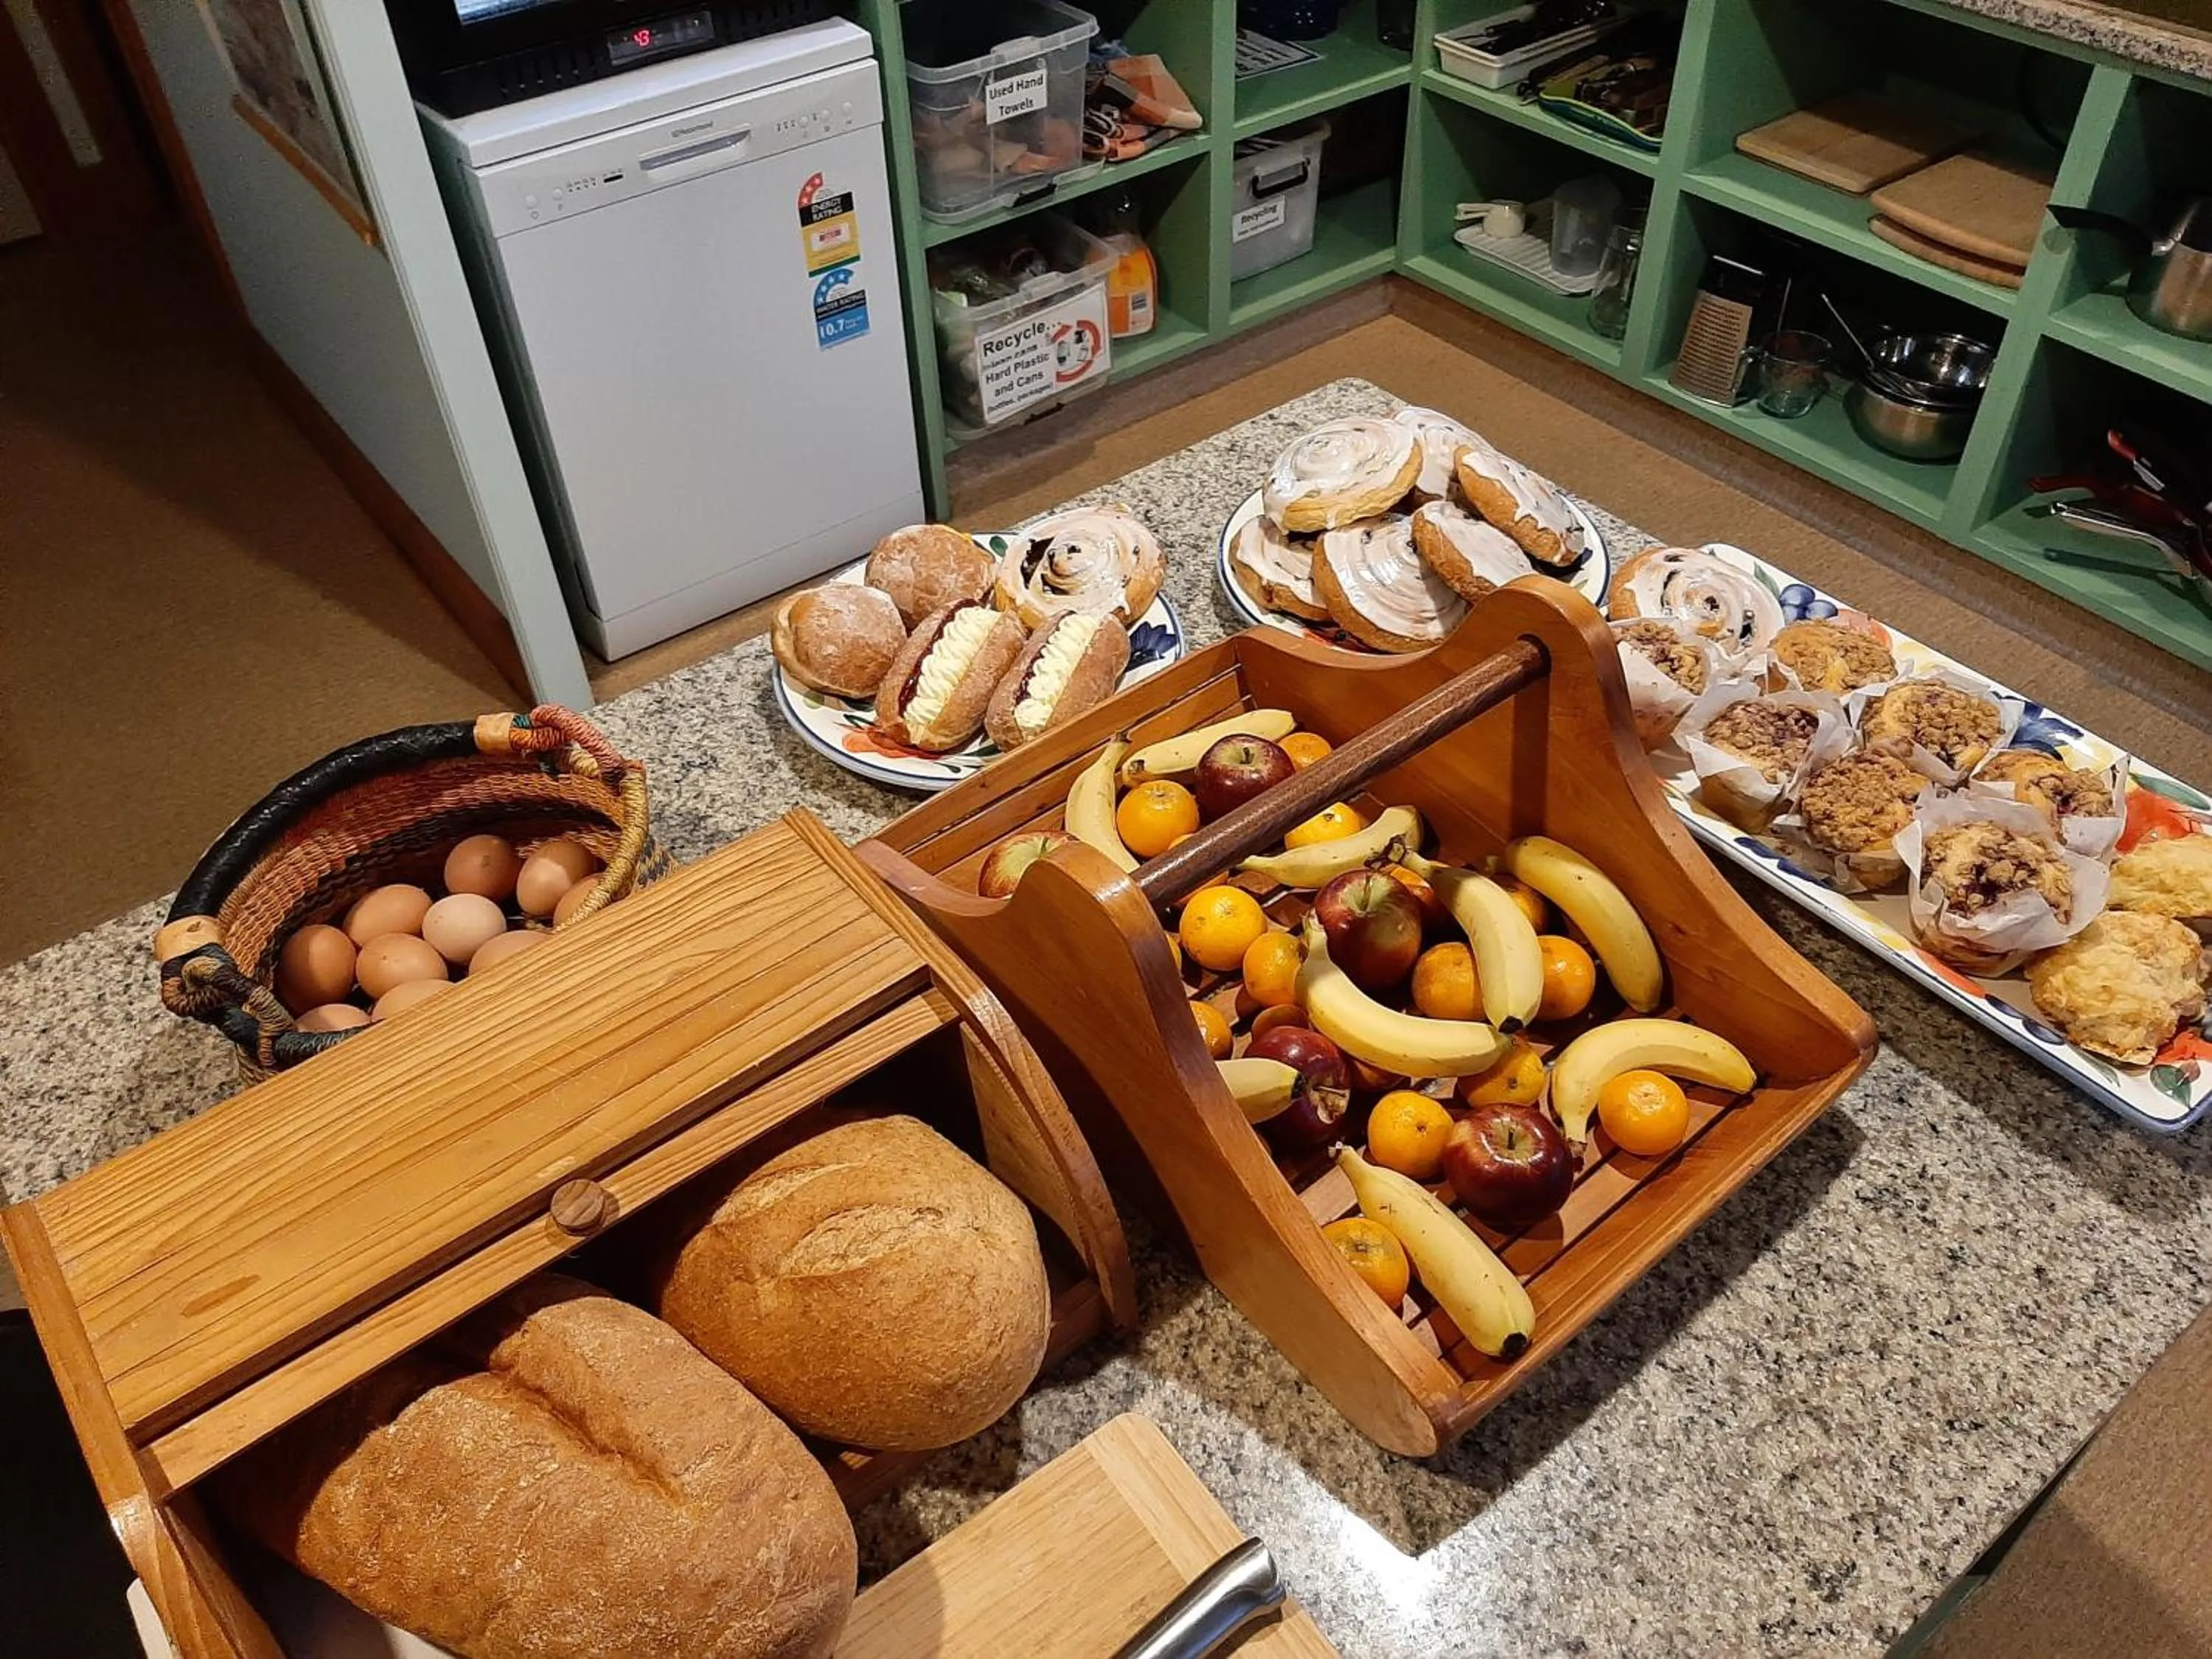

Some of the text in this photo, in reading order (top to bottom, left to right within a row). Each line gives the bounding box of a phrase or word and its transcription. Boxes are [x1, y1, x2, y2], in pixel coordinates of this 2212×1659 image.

[990, 74, 1043, 100] Used Hand
[999, 97, 1034, 116] Towels
[812, 198, 841, 214] ENERGY
[813, 207, 843, 222] RATING
[819, 318, 844, 339] 10.7
[986, 353, 1050, 384] Hard Plastic
[995, 371, 1043, 397] and Cans
